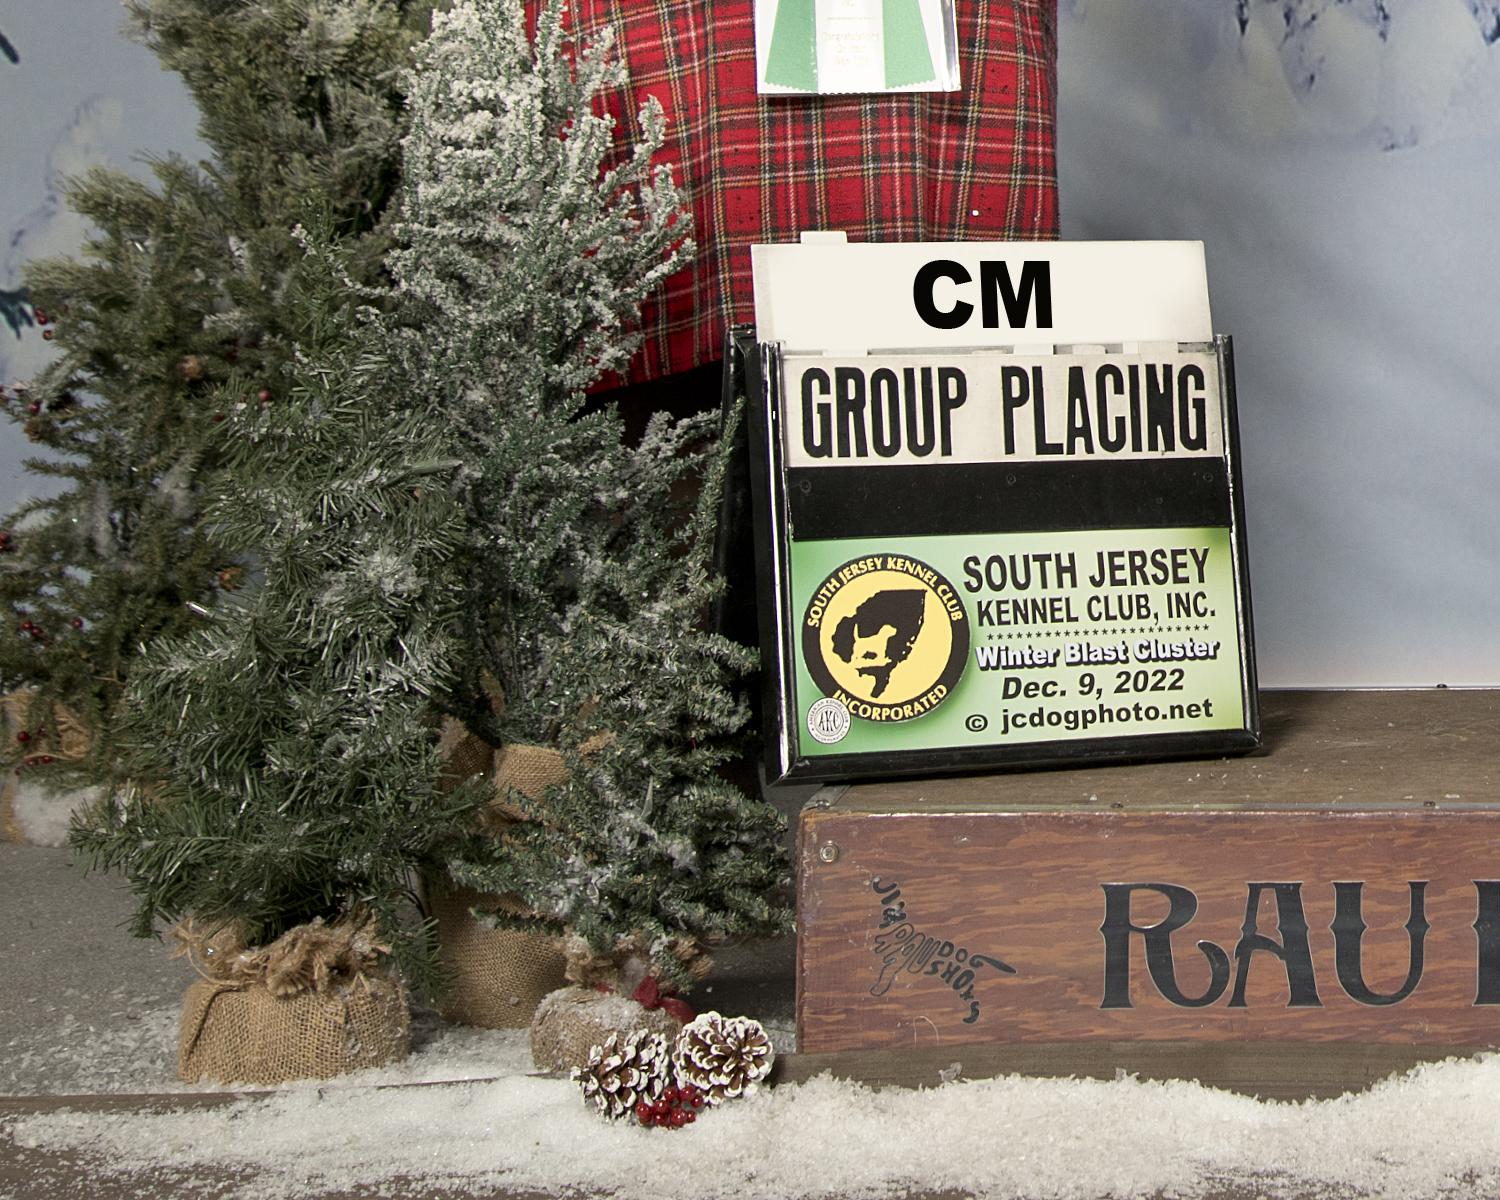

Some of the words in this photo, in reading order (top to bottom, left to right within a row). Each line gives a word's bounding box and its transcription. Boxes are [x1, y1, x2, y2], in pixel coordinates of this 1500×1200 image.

[913, 259, 1053, 329] CM
[802, 366, 967, 458] GROUP
[1001, 363, 1208, 456] PLACING
[963, 552, 1077, 593] SOUTH
[1089, 547, 1209, 588] JERSEY
[807, 580, 841, 628] SOUTH
[837, 557, 883, 585] JERSEY
[887, 556, 938, 587] KENNEL
[936, 584, 963, 622] CLUB
[977, 596, 1079, 627] KENNEL
[1087, 593, 1159, 625] CLUB,
[1166, 591, 1216, 619] INC.
[975, 645, 1060, 671] Winter
[1064, 641, 1129, 666] Blast
[1132, 637, 1220, 661] Cluster
[832, 684, 948, 720] INCORPORATED
[1001, 676, 1067, 700] Dec.
[1078, 672, 1103, 700] 9,
[1114, 668, 1185, 694] 2022
[819, 710, 840, 731] AKC
[1001, 698, 1213, 735] jcdogphoto.net
[937, 940, 1017, 974] DOG
[1099, 879, 1431, 1009] RAU
